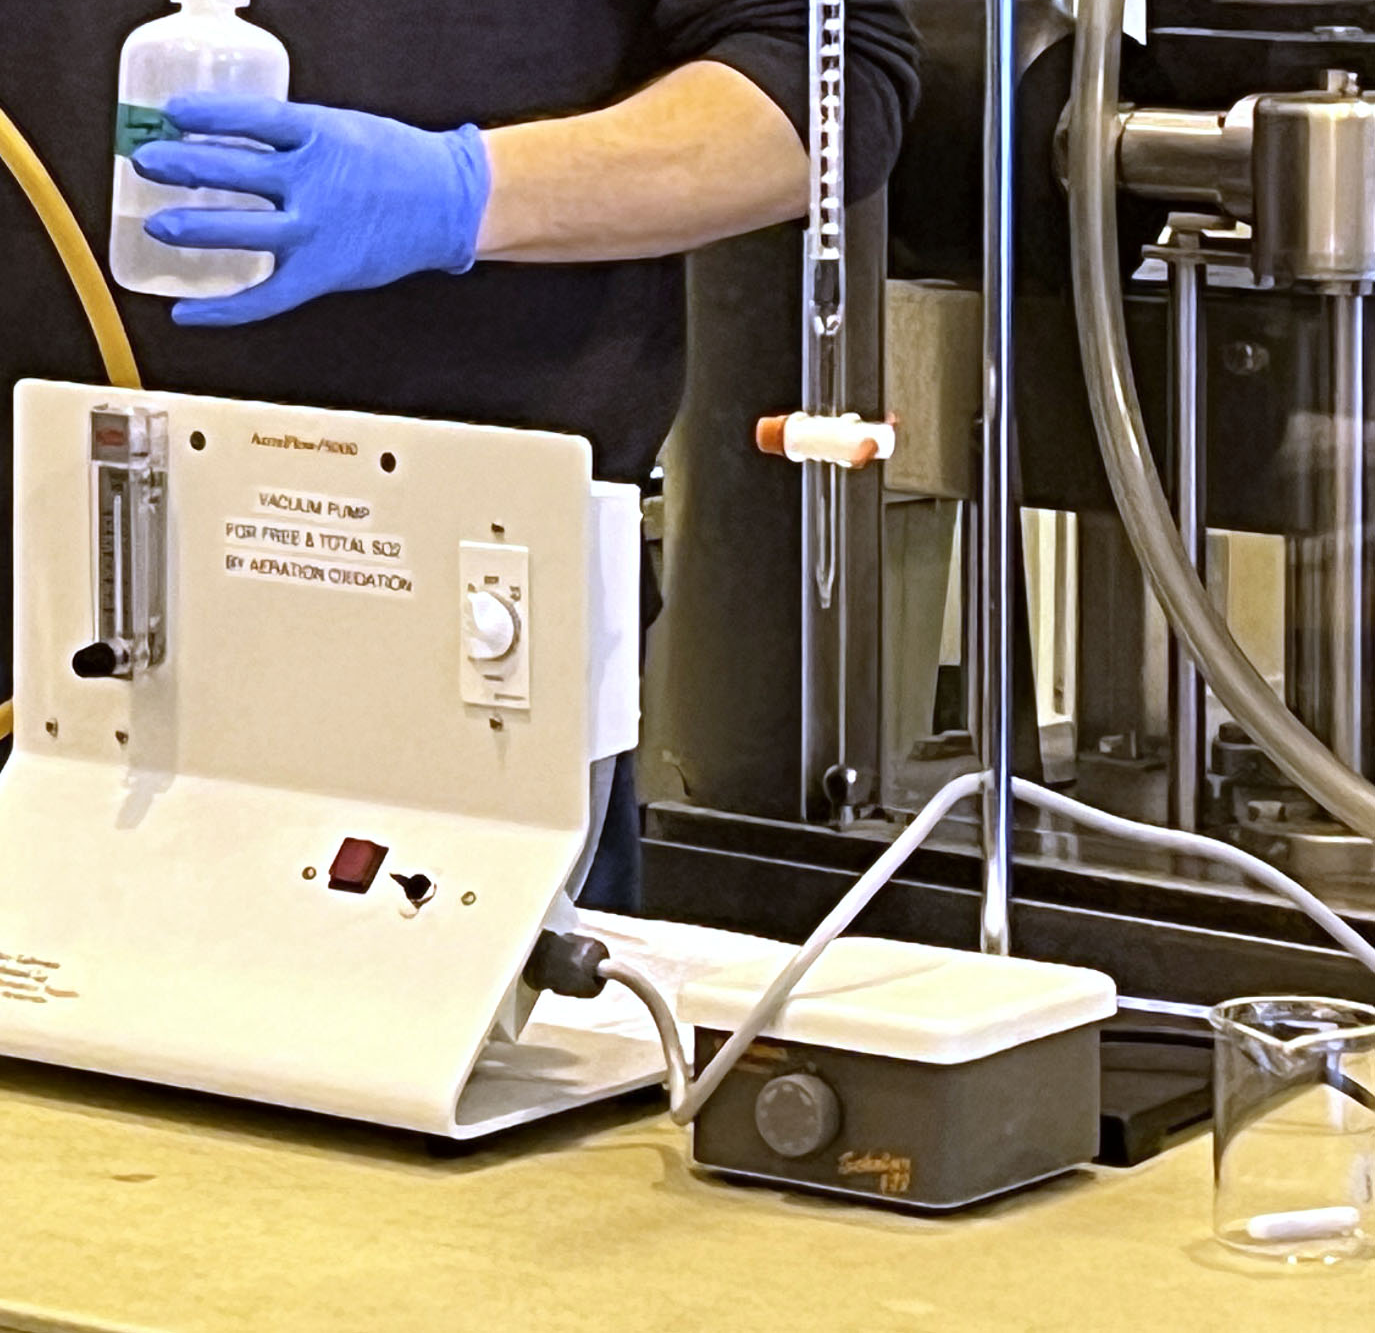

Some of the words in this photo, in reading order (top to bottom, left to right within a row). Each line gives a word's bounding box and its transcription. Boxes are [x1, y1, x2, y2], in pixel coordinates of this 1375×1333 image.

[258, 492, 323, 516] VACUUM
[327, 501, 370, 520] PUMP
[225, 522, 257, 540] FOR
[262, 525, 301, 547] FREE
[319, 532, 366, 555] TOTAL
[372, 539, 401, 559] SO2
[225, 554, 245, 570] BY
[250, 557, 325, 582] AERATION
[327, 568, 413, 593] OXIDATION
